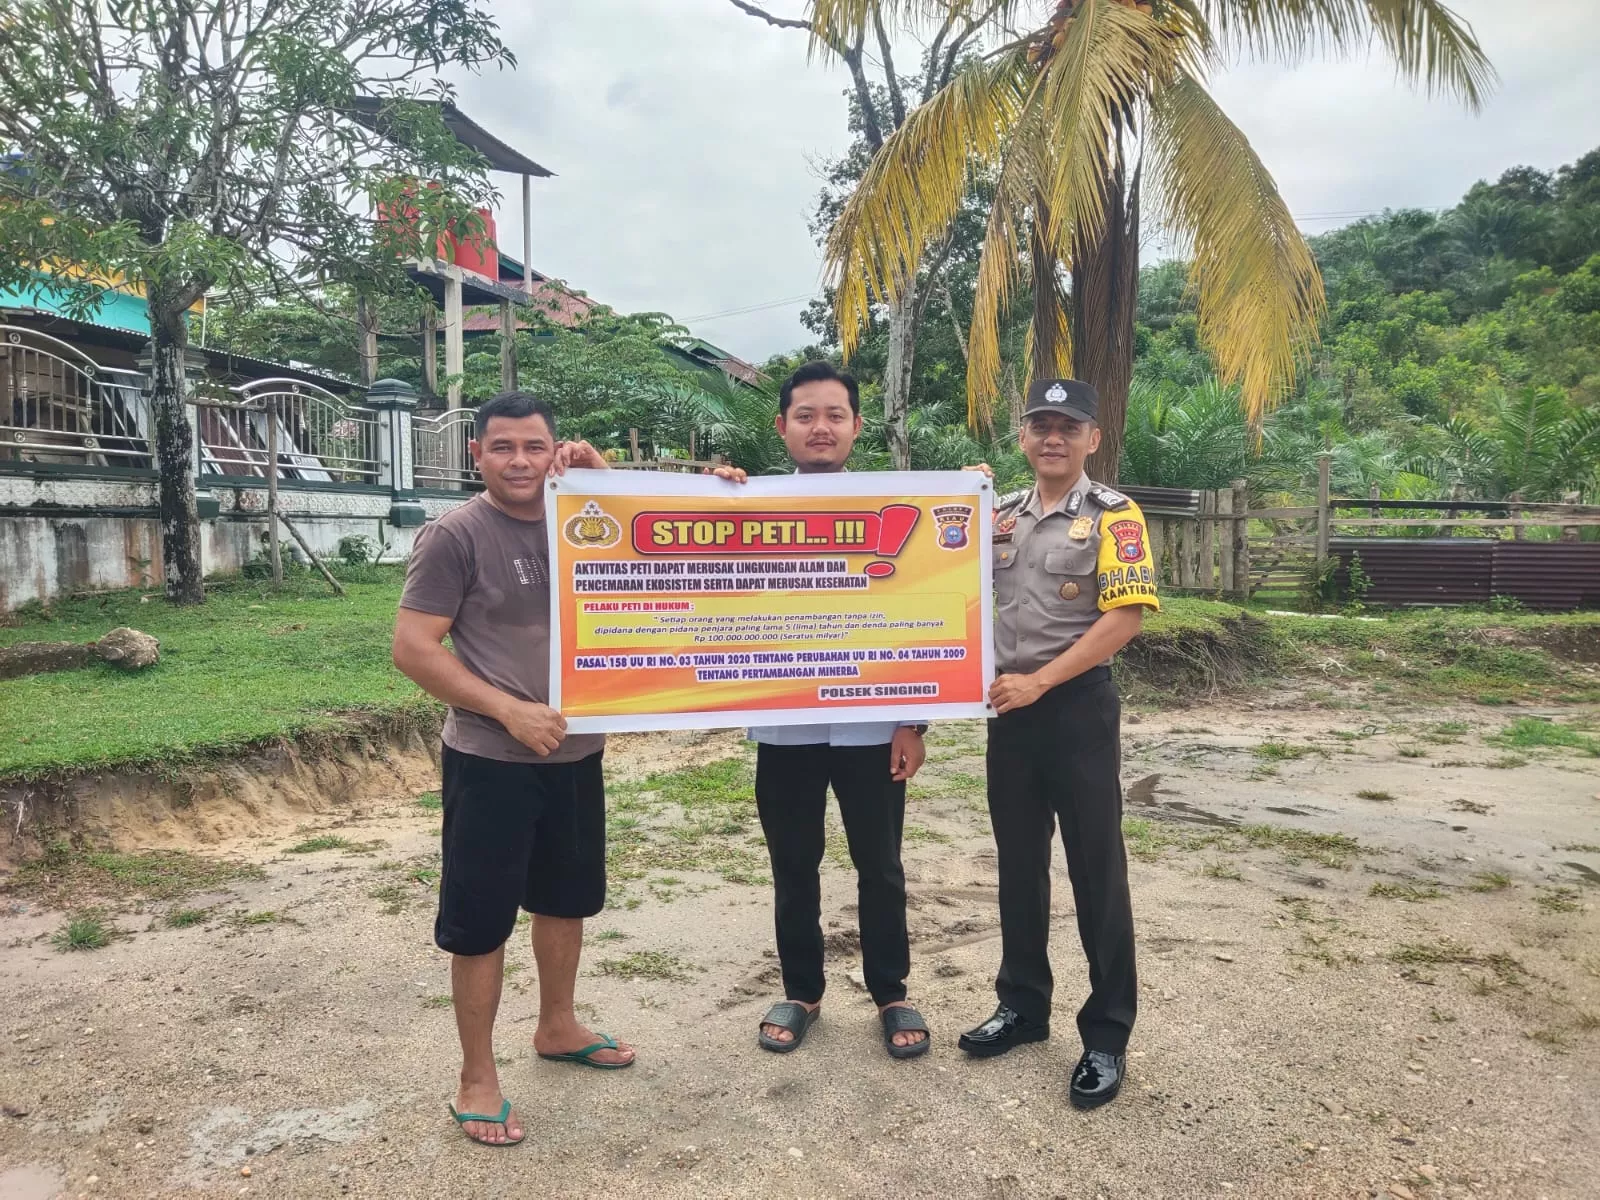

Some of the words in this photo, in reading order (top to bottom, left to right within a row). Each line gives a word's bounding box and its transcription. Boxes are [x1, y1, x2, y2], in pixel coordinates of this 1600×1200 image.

[652, 520, 736, 546] STOP
[834, 519, 865, 544] !!!
[575, 563, 628, 575] AKTIVITAS
[630, 563, 651, 574] PETI
[654, 563, 685, 574] DAPAT
[687, 562, 735, 574] MERUSAK
[737, 562, 797, 573] LINGKUNGAN
[799, 562, 825, 572] ALAM
[827, 561, 846, 572] DAN
[576, 579, 643, 591] PENCEMARAN
[646, 579, 701, 590] EKOSISTEM
[704, 579, 733, 590] SERTA
[736, 578, 765, 589] DAPAT
[768, 578, 813, 589] MERUSAK
[816, 577, 867, 588] KESEHATAN
[584, 603, 619, 611] PELAKU
[621, 603, 641, 611] PETI
[655, 602, 689, 610] HUKUM
[660, 616, 686, 624] Setiap
[689, 616, 712, 624] orang
[715, 616, 735, 624] yang
[784, 613, 841, 621] penambangan
[595, 626, 632, 634] dipidana
[635, 626, 667, 634] dengan
[669, 625, 698, 633] pidana
[700, 624, 732, 632] penjara
[735, 624, 761, 632] paling
[793, 622, 817, 630] (lima)
[916, 620, 944, 628] banyak
[694, 635, 705, 643] Rp
[707, 633, 778, 642] 100.000.000.000
[780, 632, 814, 640] (Seratus
[577, 657, 606, 668] PASAL
[609, 657, 627, 667] 158
[631, 656, 643, 667] UU
[646, 656, 656, 666] RI
[659, 656, 676, 666] NO.
[679, 655, 690, 666] 03
[693, 655, 725, 665] TAHUN
[727, 654, 750, 664] 2020
[753, 653, 794, 664] TENTANG
[796, 652, 850, 662] PERUBAHAN
[853, 651, 865, 661] UU
[868, 650, 877, 660] RI
[879, 650, 896, 660] NO.
[898, 650, 909, 660] 04
[911, 649, 941, 659] TAHUN
[943, 648, 965, 658] 2009
[697, 669, 739, 681] TENTANG
[742, 667, 816, 679] PERTAMBANGAN
[818, 666, 859, 676] MINERBA
[820, 687, 871, 698] POLSEK
[874, 685, 937, 696] SINGINGI
